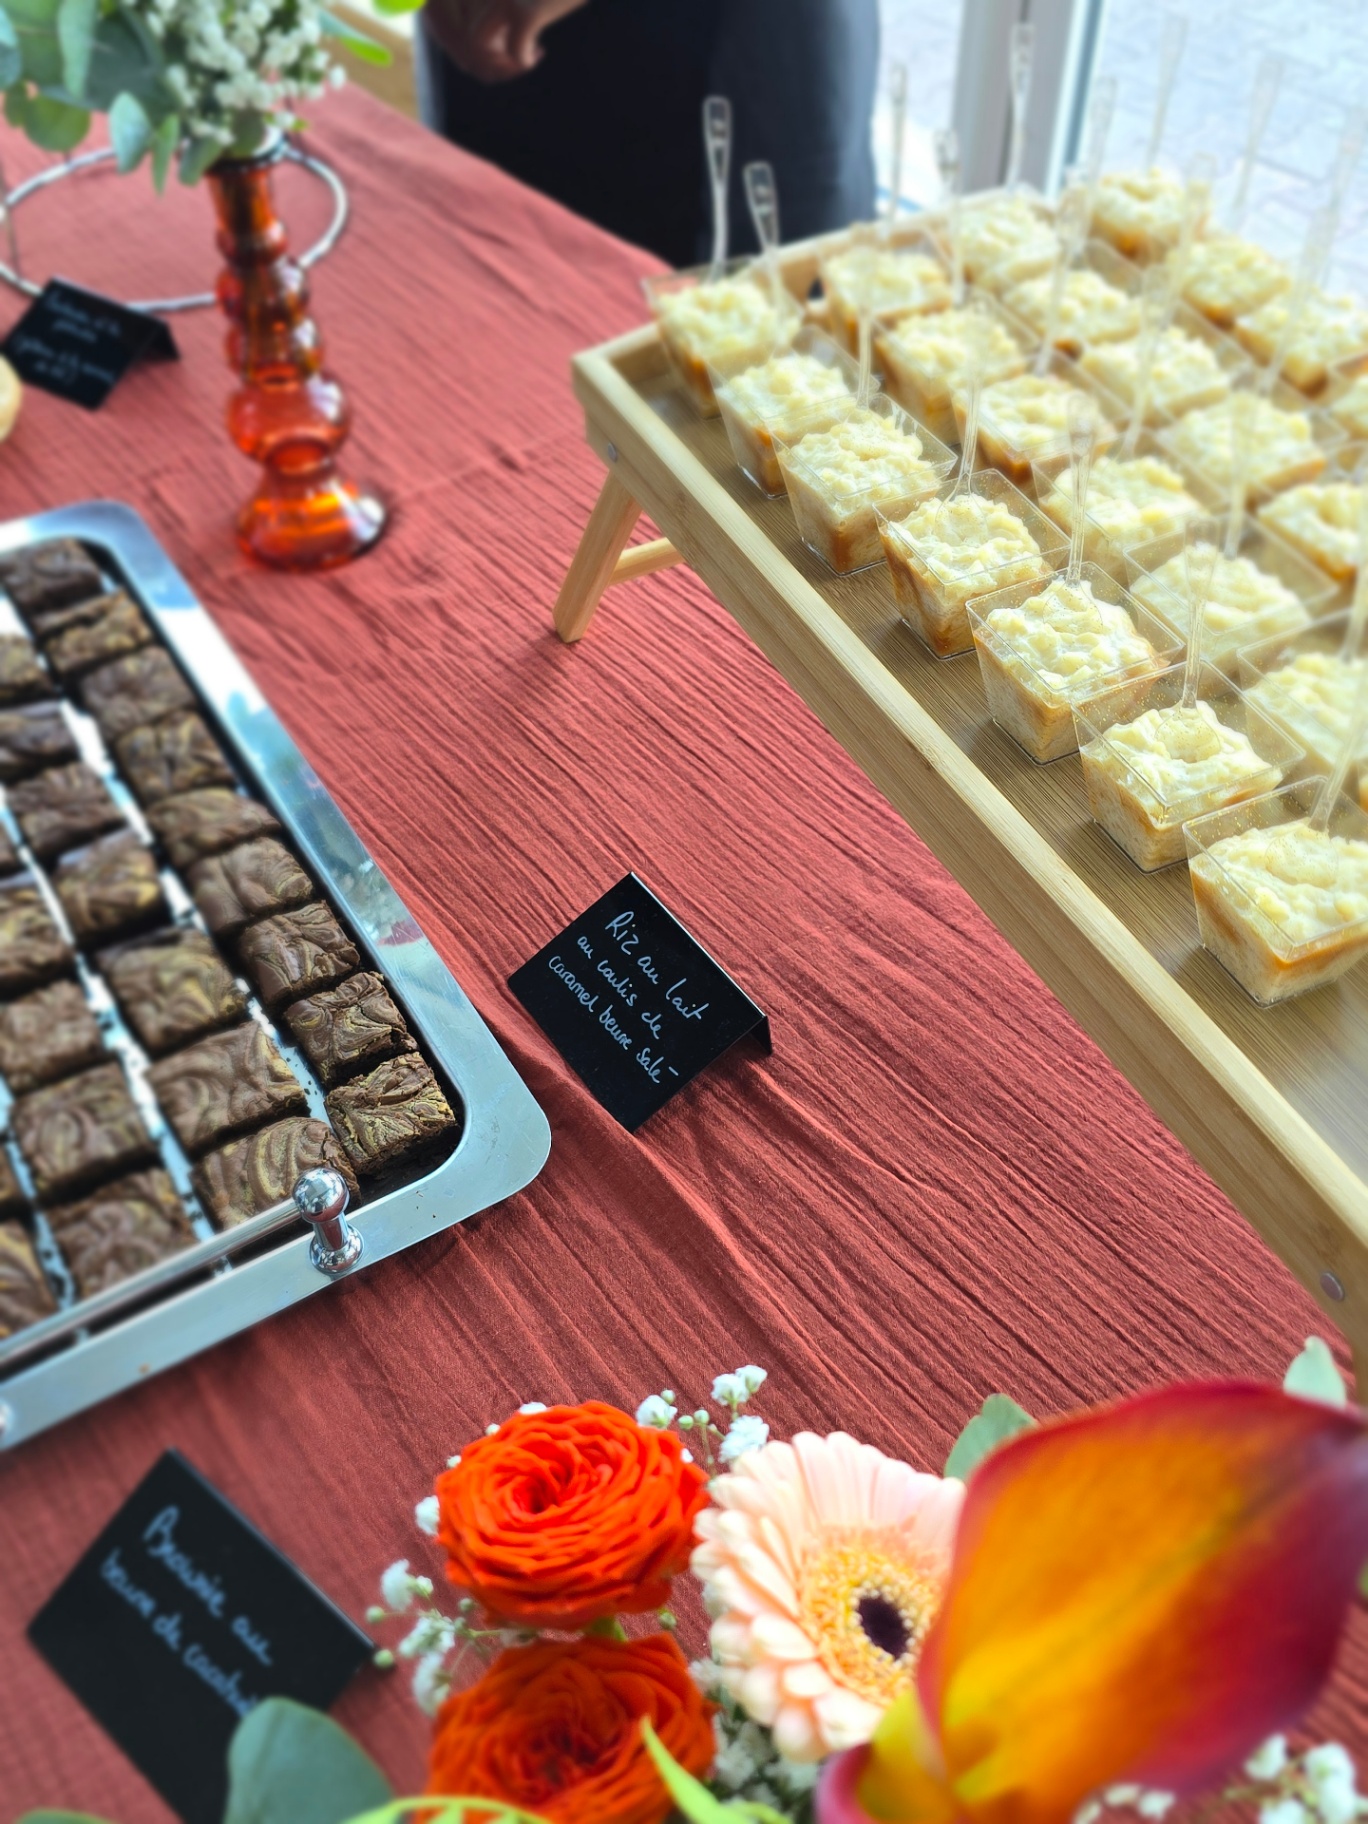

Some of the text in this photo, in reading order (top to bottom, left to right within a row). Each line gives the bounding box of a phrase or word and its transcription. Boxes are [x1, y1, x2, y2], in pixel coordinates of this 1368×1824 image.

[549, 955, 598, 1012] caramel
[599, 1005, 632, 1050] beurre
[577, 936, 661, 1039] au coulis de
[604, 911, 709, 1020] Riz au lait
[153, 1612, 182, 1651] de
